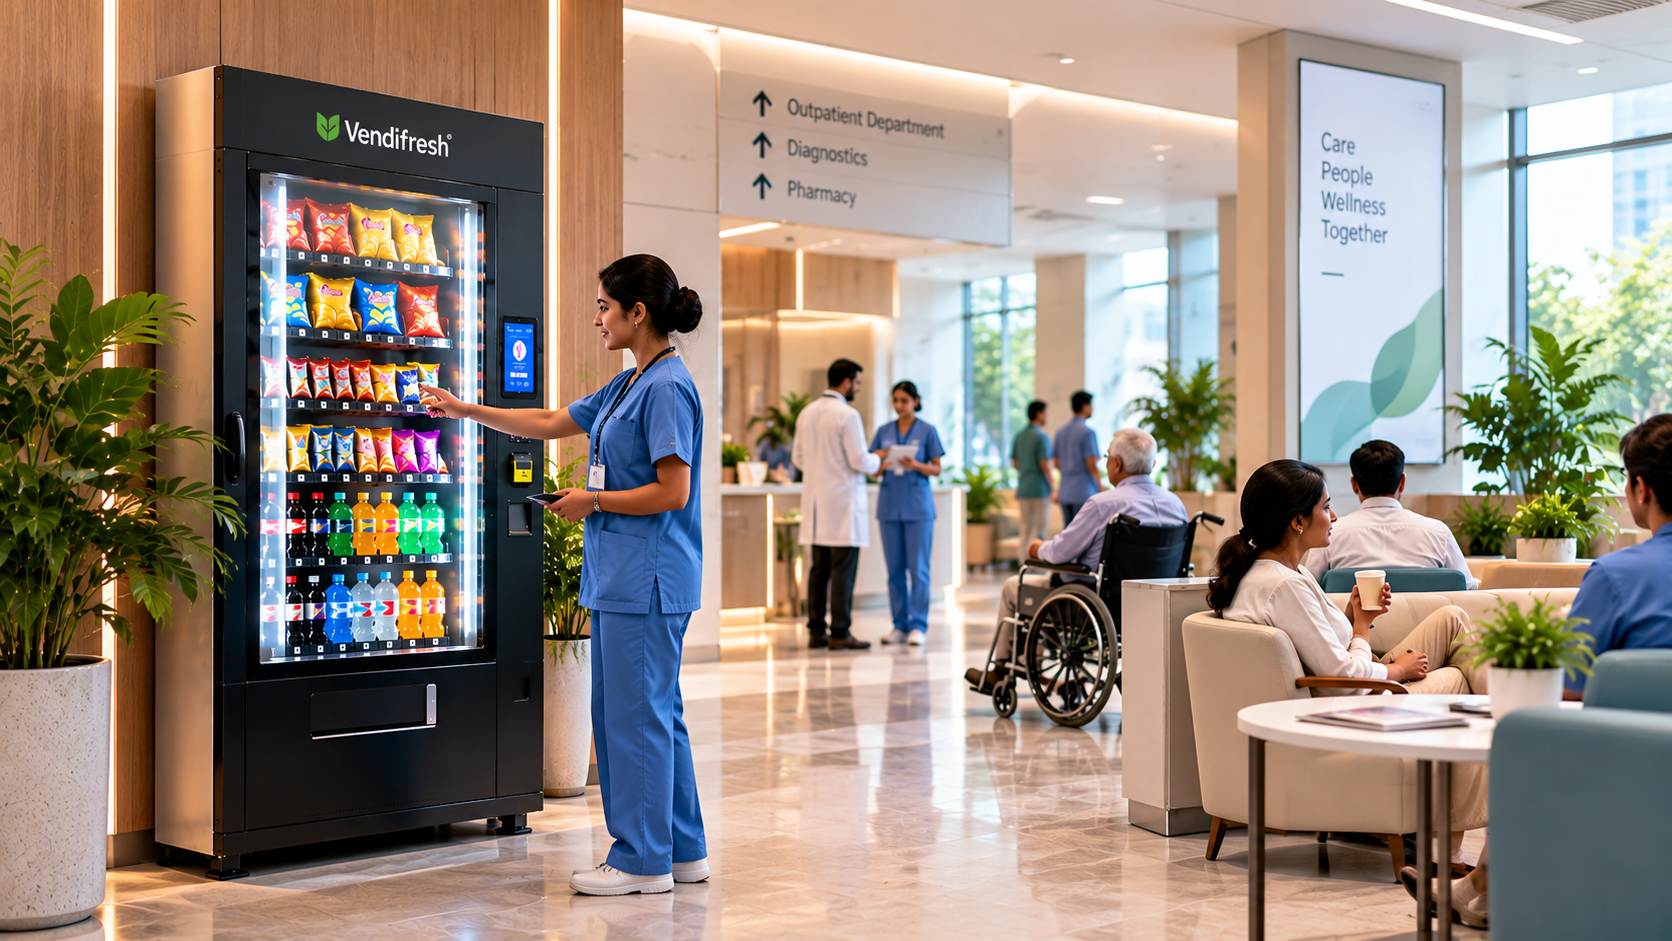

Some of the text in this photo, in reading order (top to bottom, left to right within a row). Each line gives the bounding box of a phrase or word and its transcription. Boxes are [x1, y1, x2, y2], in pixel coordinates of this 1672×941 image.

[787, 98, 945, 139] Outpatient Department
[787, 139, 868, 166] Diagnostics
[1321, 131, 1356, 155] Care
[1321, 161, 1373, 188] People
[787, 180, 857, 208] Pharmacy
[1321, 190, 1387, 216] Wellness
[1321, 219, 1388, 245] Together
